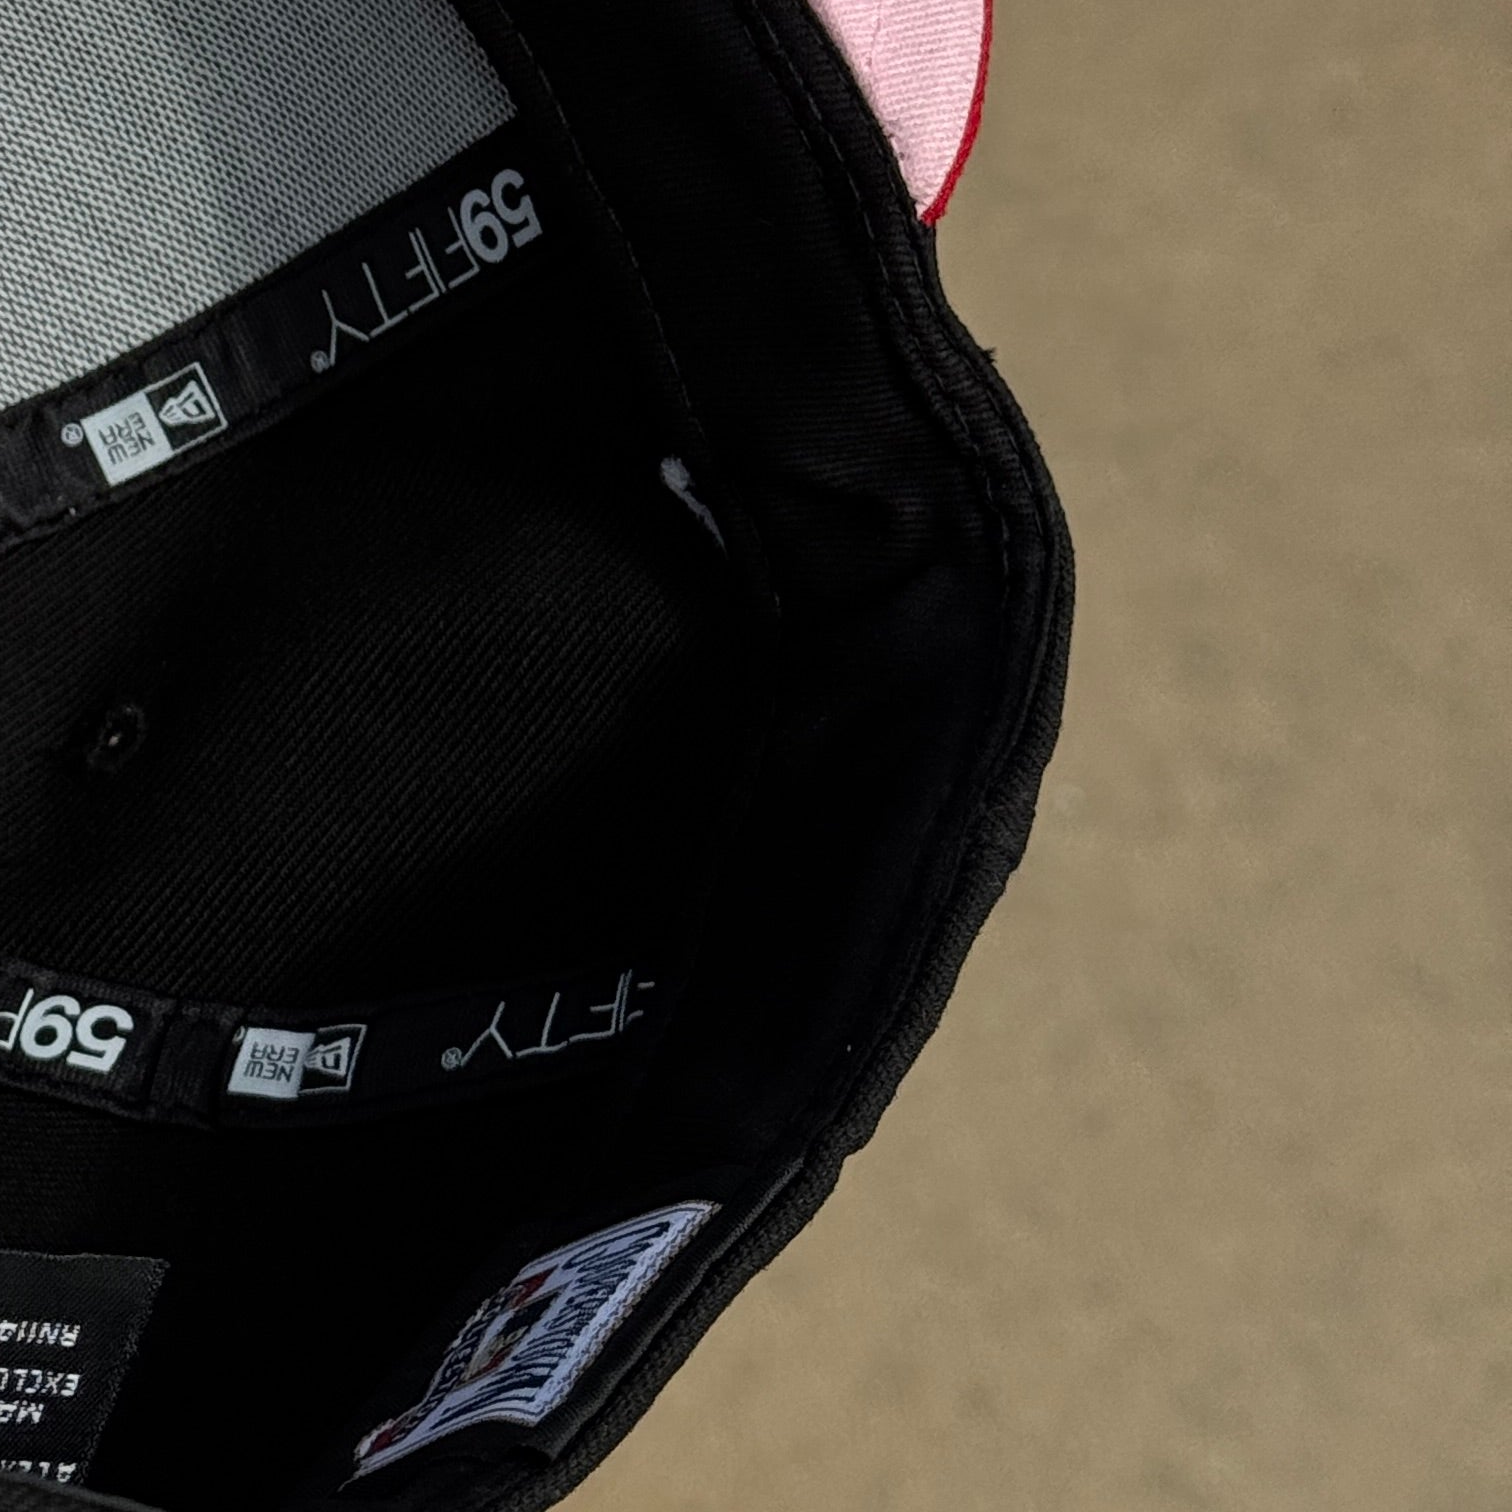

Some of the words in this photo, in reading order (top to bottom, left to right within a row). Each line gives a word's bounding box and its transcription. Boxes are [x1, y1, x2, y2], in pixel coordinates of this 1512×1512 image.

[98, 411, 147, 445] ERA
[107, 431, 156, 465] NEW
[249, 1040, 301, 1065] ERA
[243, 1059, 296, 1084] NEW
